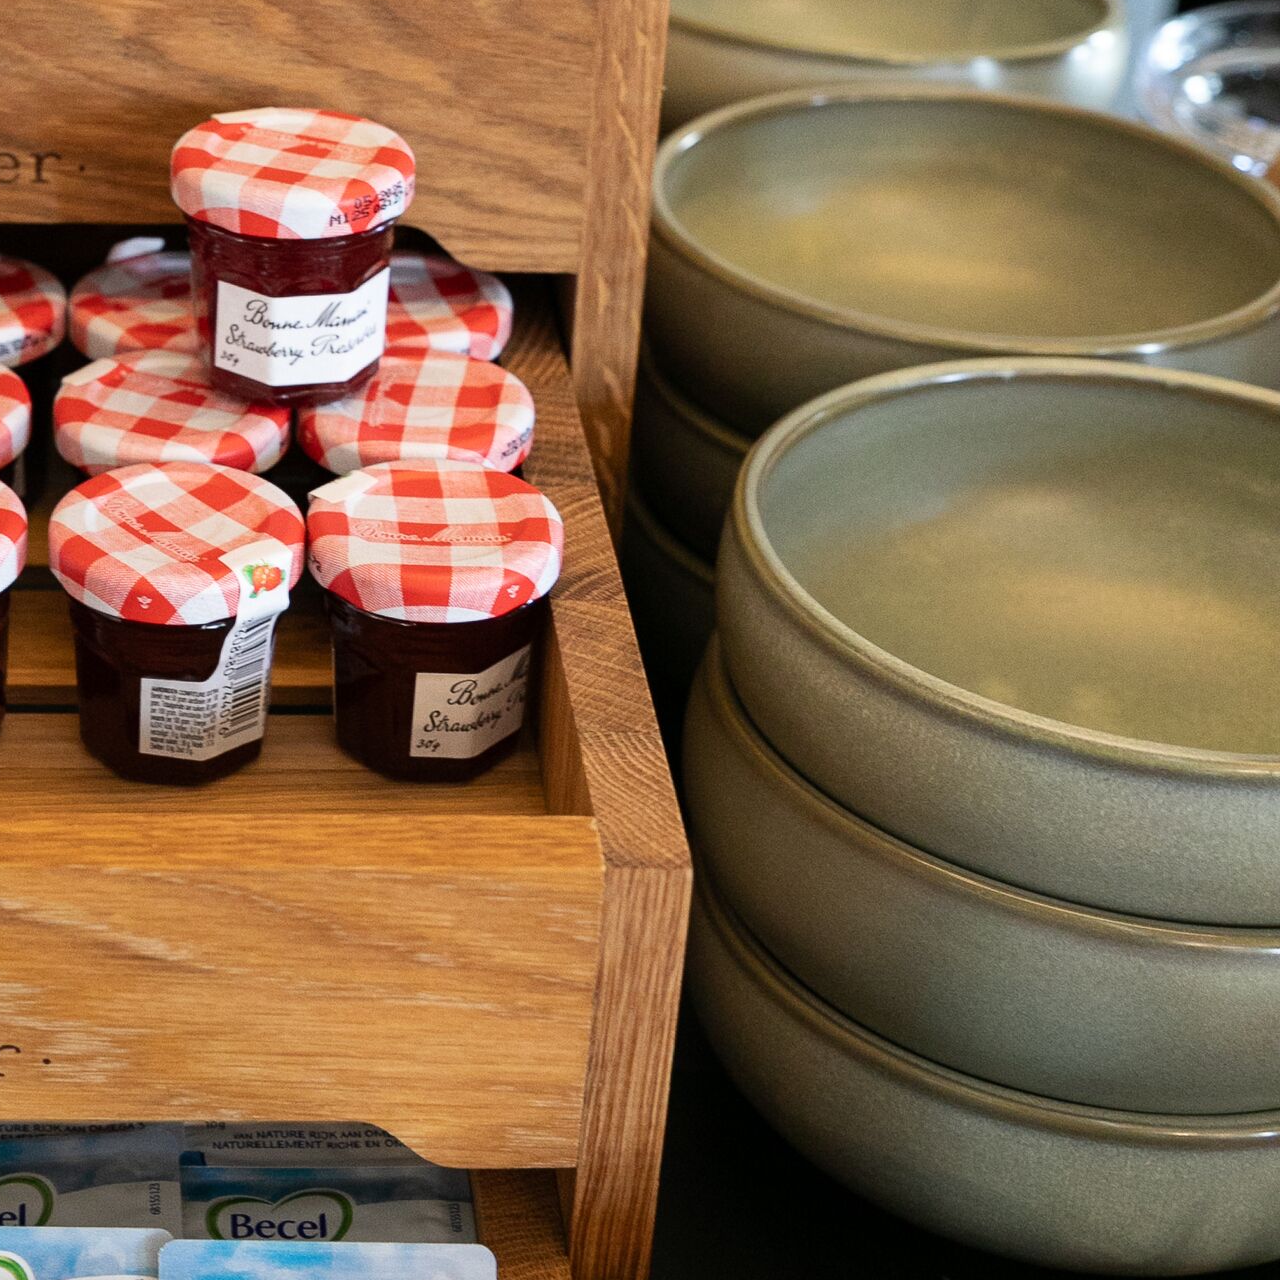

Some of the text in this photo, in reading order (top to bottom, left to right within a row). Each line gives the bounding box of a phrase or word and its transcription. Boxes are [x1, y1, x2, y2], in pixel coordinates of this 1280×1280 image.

[244, 299, 305, 330] Bonne
[225, 324, 304, 365] Strawberry
[212, 1140, 321, 1150] NATURELLEMENT
[326, 1140, 360, 1149] RICHE
[364, 1140, 381, 1148] EN
[256, 1130, 306, 1140] NATURE
[340, 1130, 363, 1139] AAN
[231, 1212, 328, 1240] Becel
